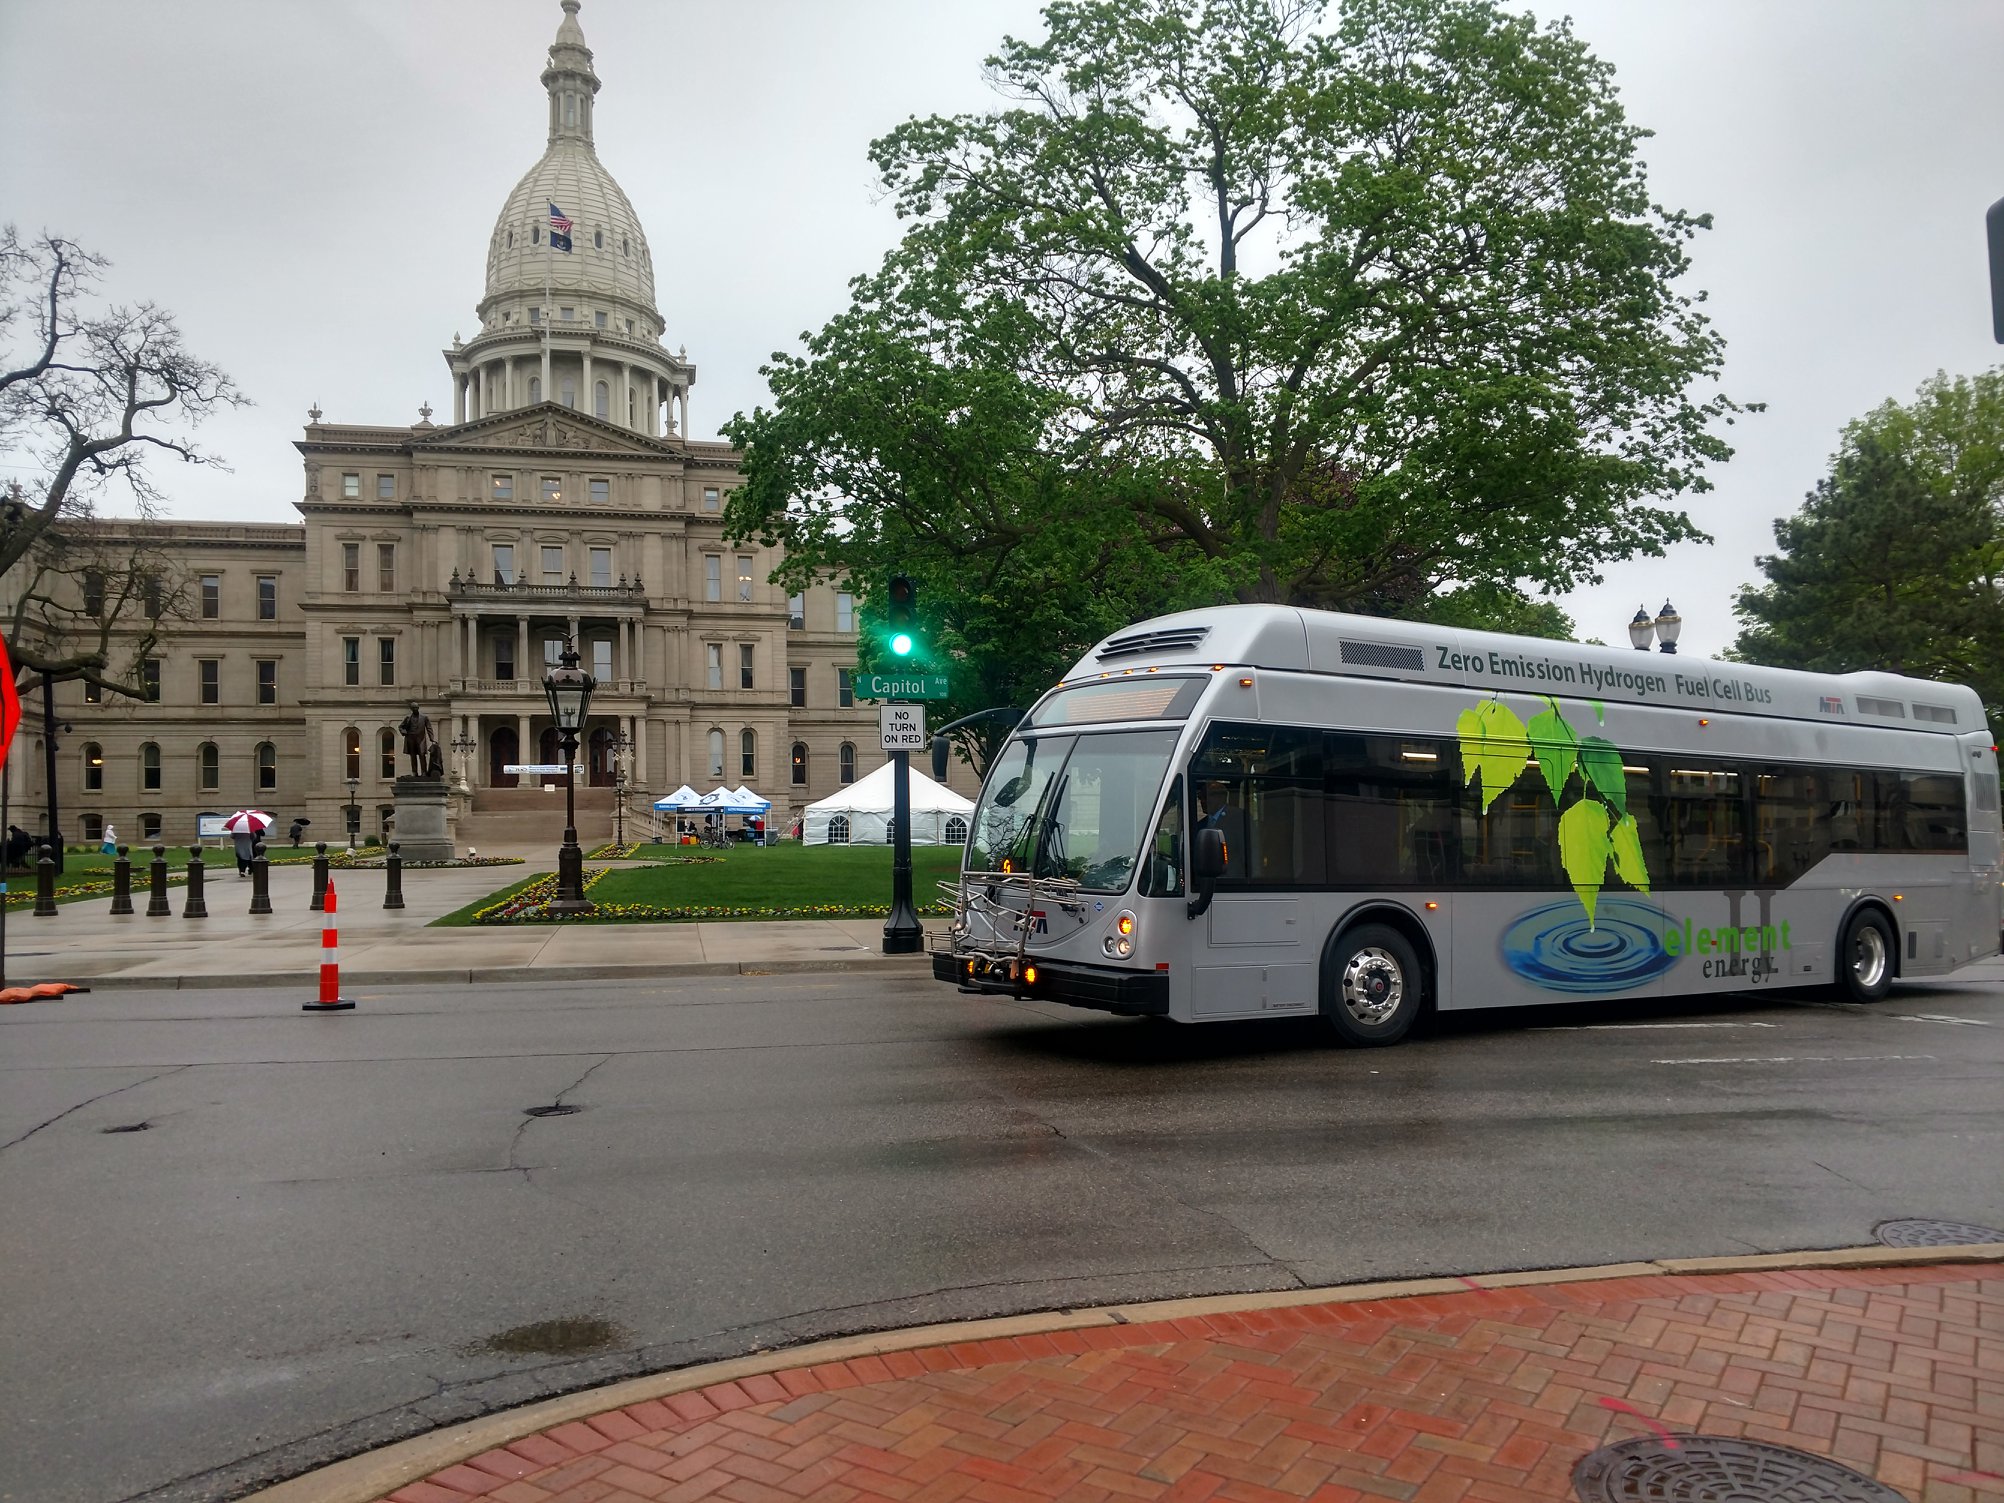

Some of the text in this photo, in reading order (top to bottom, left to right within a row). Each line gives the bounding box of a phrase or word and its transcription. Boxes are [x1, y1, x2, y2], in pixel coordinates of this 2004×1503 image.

[1436, 645, 1772, 704] Zero Emission Hydrogen Fuel Cell Bus
[856, 676, 948, 697] N Capitol Ave
[894, 711, 910, 720] NO
[888, 723, 916, 732] TURN
[884, 734, 921, 744] ON RED
[1702, 957, 1775, 984] energy
